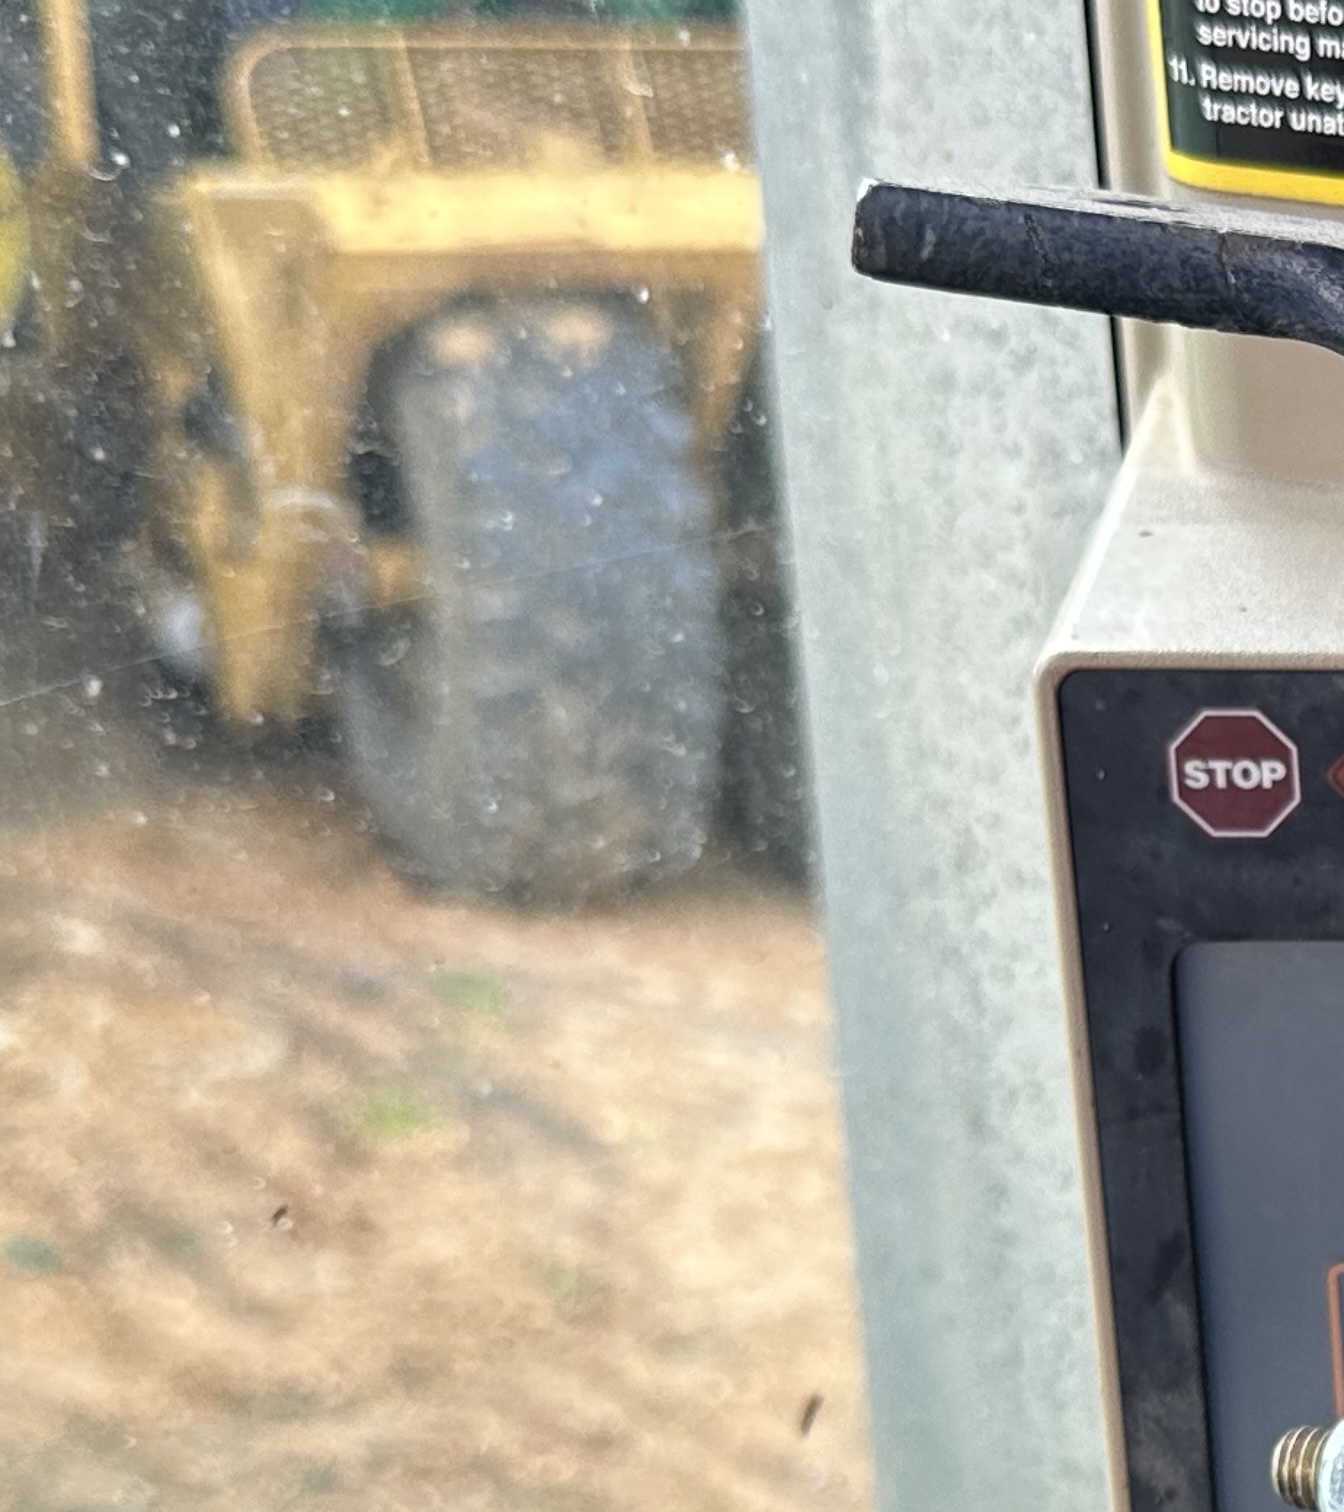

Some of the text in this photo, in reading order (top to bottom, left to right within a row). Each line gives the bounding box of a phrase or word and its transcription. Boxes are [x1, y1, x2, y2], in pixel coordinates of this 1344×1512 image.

[1226, 0, 1281, 24] stop
[1196, 22, 1311, 61] servicing
[1168, 54, 1196, 87] 11.
[1201, 63, 1301, 99] Remove
[1201, 94, 1284, 129] tractor
[1183, 759, 1288, 790] STOP
